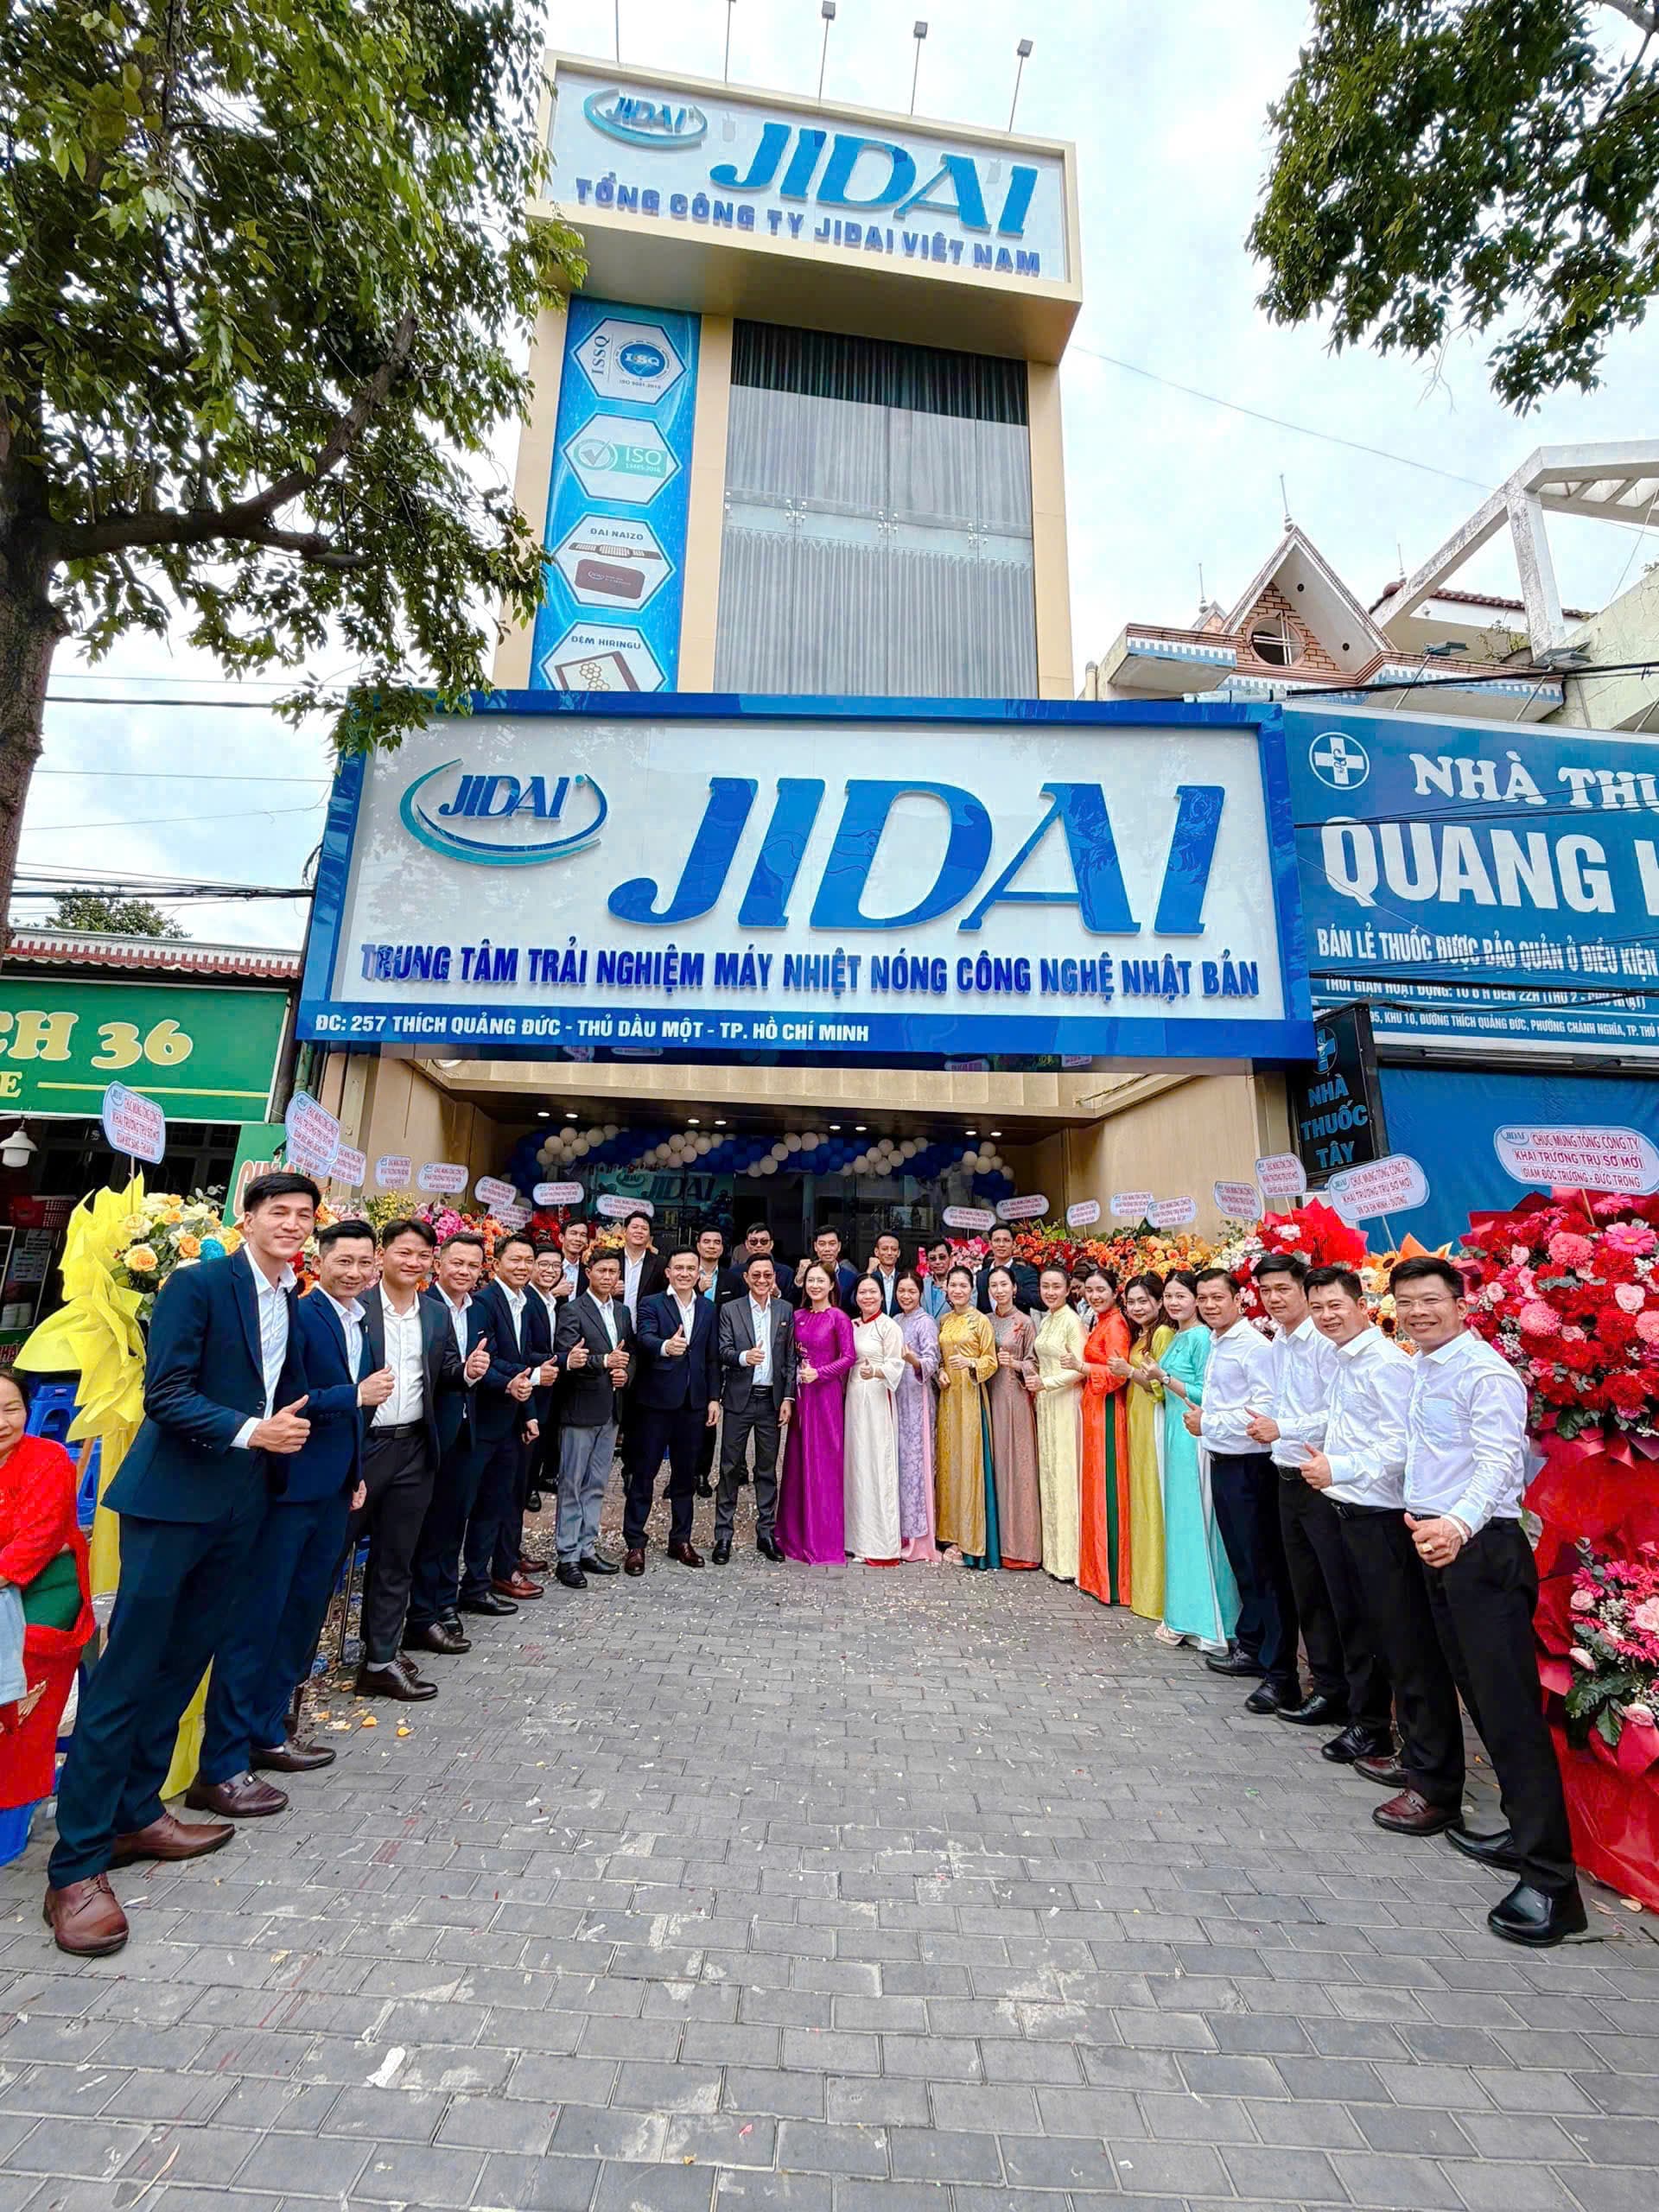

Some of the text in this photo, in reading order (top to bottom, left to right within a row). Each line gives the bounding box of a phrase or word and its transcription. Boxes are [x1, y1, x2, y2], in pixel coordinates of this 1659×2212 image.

[606, 96, 687, 132] JIDAI
[710, 122, 1039, 236] JIDAI
[576, 171, 660, 216] TỔNG
[670, 192, 755, 232] CÔNG
[767, 208, 804, 238] TY
[815, 218, 893, 254] JIDAI
[974, 243, 1040, 276] NAM
[591, 334, 610, 375] ISSQ
[626, 448, 662, 463] ISO
[612, 531, 644, 541] NAIZO
[598, 639, 641, 649] HIRINGU
[438, 773, 570, 820] JIDAI
[1409, 751, 1548, 805] NHÀ
[607, 777, 1225, 937] JIDAI
[1320, 816, 1616, 913] QUANG
[360, 936, 1260, 1003] TRUNG TÂM TRẢI NGHIỆM MÁY NHIỆT NÓNG CÔNG NGHỆ NHẬT BẢN
[1317, 924, 1353, 957] BÁN
[1356, 922, 1377, 959] LẺ
[1378, 925, 1433, 962] THUỐC
[1435, 933, 1480, 971] ĐƯỢC
[1482, 930, 1516, 969] BẢO
[1620, 941, 1659, 982] KIỆN
[315, 1014, 346, 1032] ĐC:
[350, 1015, 386, 1032] 257
[392, 1011, 448, 1033] THÍCH
[451, 1012, 516, 1035] QUẢNG
[521, 1014, 561, 1035] ĐỨC
[577, 1013, 613, 1037] THỦ
[618, 1014, 656, 1037] DẦU
[662, 1017, 703, 1043] MỘT
[720, 1022, 747, 1039] TP.
[753, 1016, 778, 1039] HỒ
[782, 1020, 814, 1040] CHÍ
[819, 1024, 869, 1042] MINH
[1384, 1011, 1403, 1024] KHU
[1404, 1013, 1418, 1026] 10,
[1451, 1013, 1477, 1027] THÍCH
[1478, 1014, 1508, 1029] QUẢNG
[1567, 1020, 1596, 1034] CHÁNH
[1626, 1025, 1639, 1037] TP.
[91, 1019, 194, 1071] 36
[1307, 1073, 1350, 1108] NHÀ
[1300, 1099, 1369, 1141] THUỐC
[1316, 1140, 1355, 1168] TÂY
[1515, 1150, 1536, 1161] KHAI
[1538, 1151, 1579, 1164] TRƯƠNG
[1620, 1154, 1643, 1169] MỚI
[1627, 1137, 1639, 1150] TY
